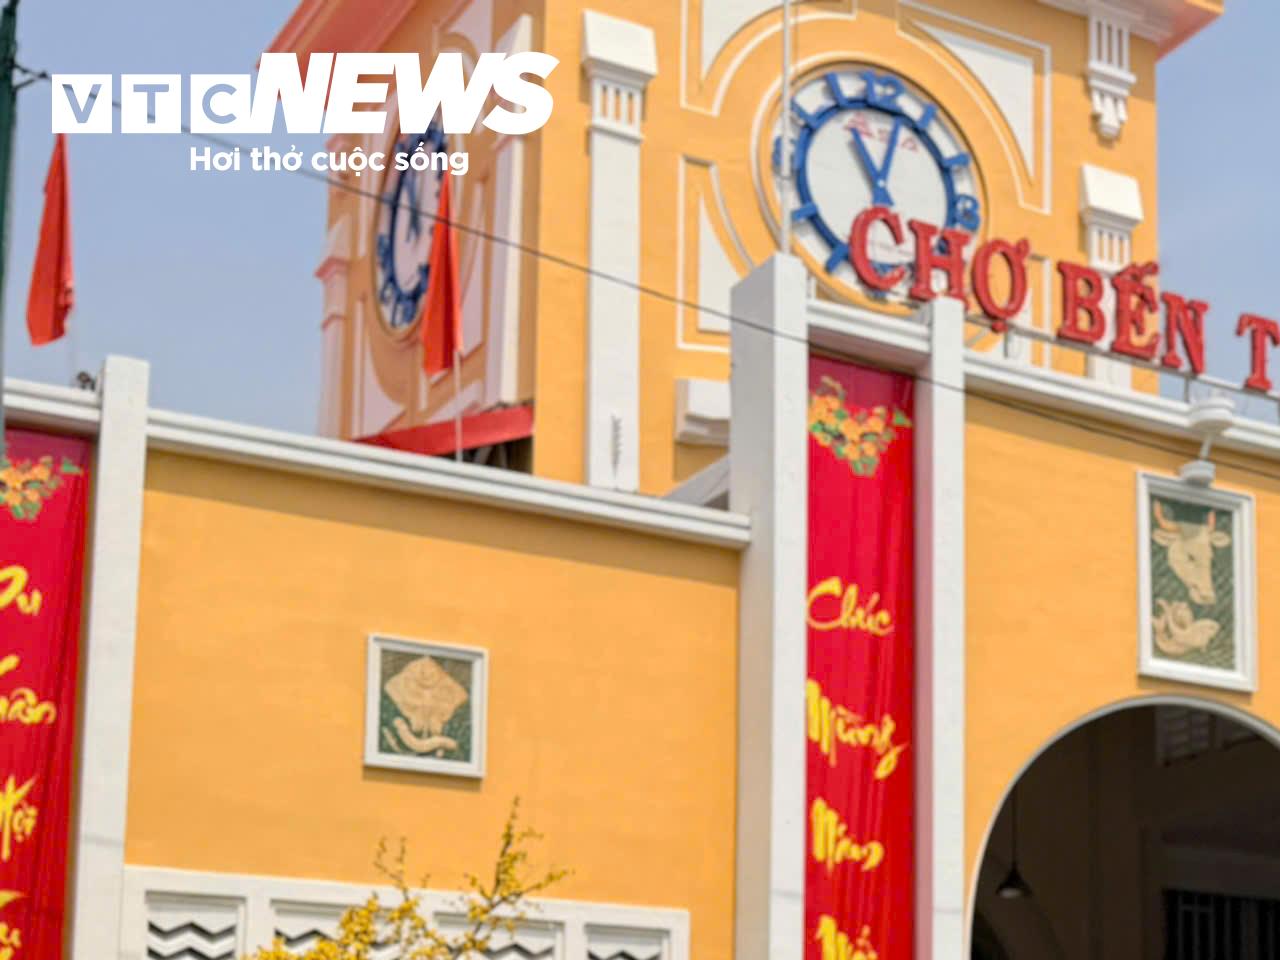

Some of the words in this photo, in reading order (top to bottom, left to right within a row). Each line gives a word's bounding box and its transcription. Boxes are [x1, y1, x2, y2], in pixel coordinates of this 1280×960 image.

[848, 205, 1031, 333] CHỢ
[1056, 261, 1209, 375] BẾN
[806, 576, 895, 637] Chúc
[805, 678, 911, 780] Mừng
[812, 797, 885, 878] Năm
